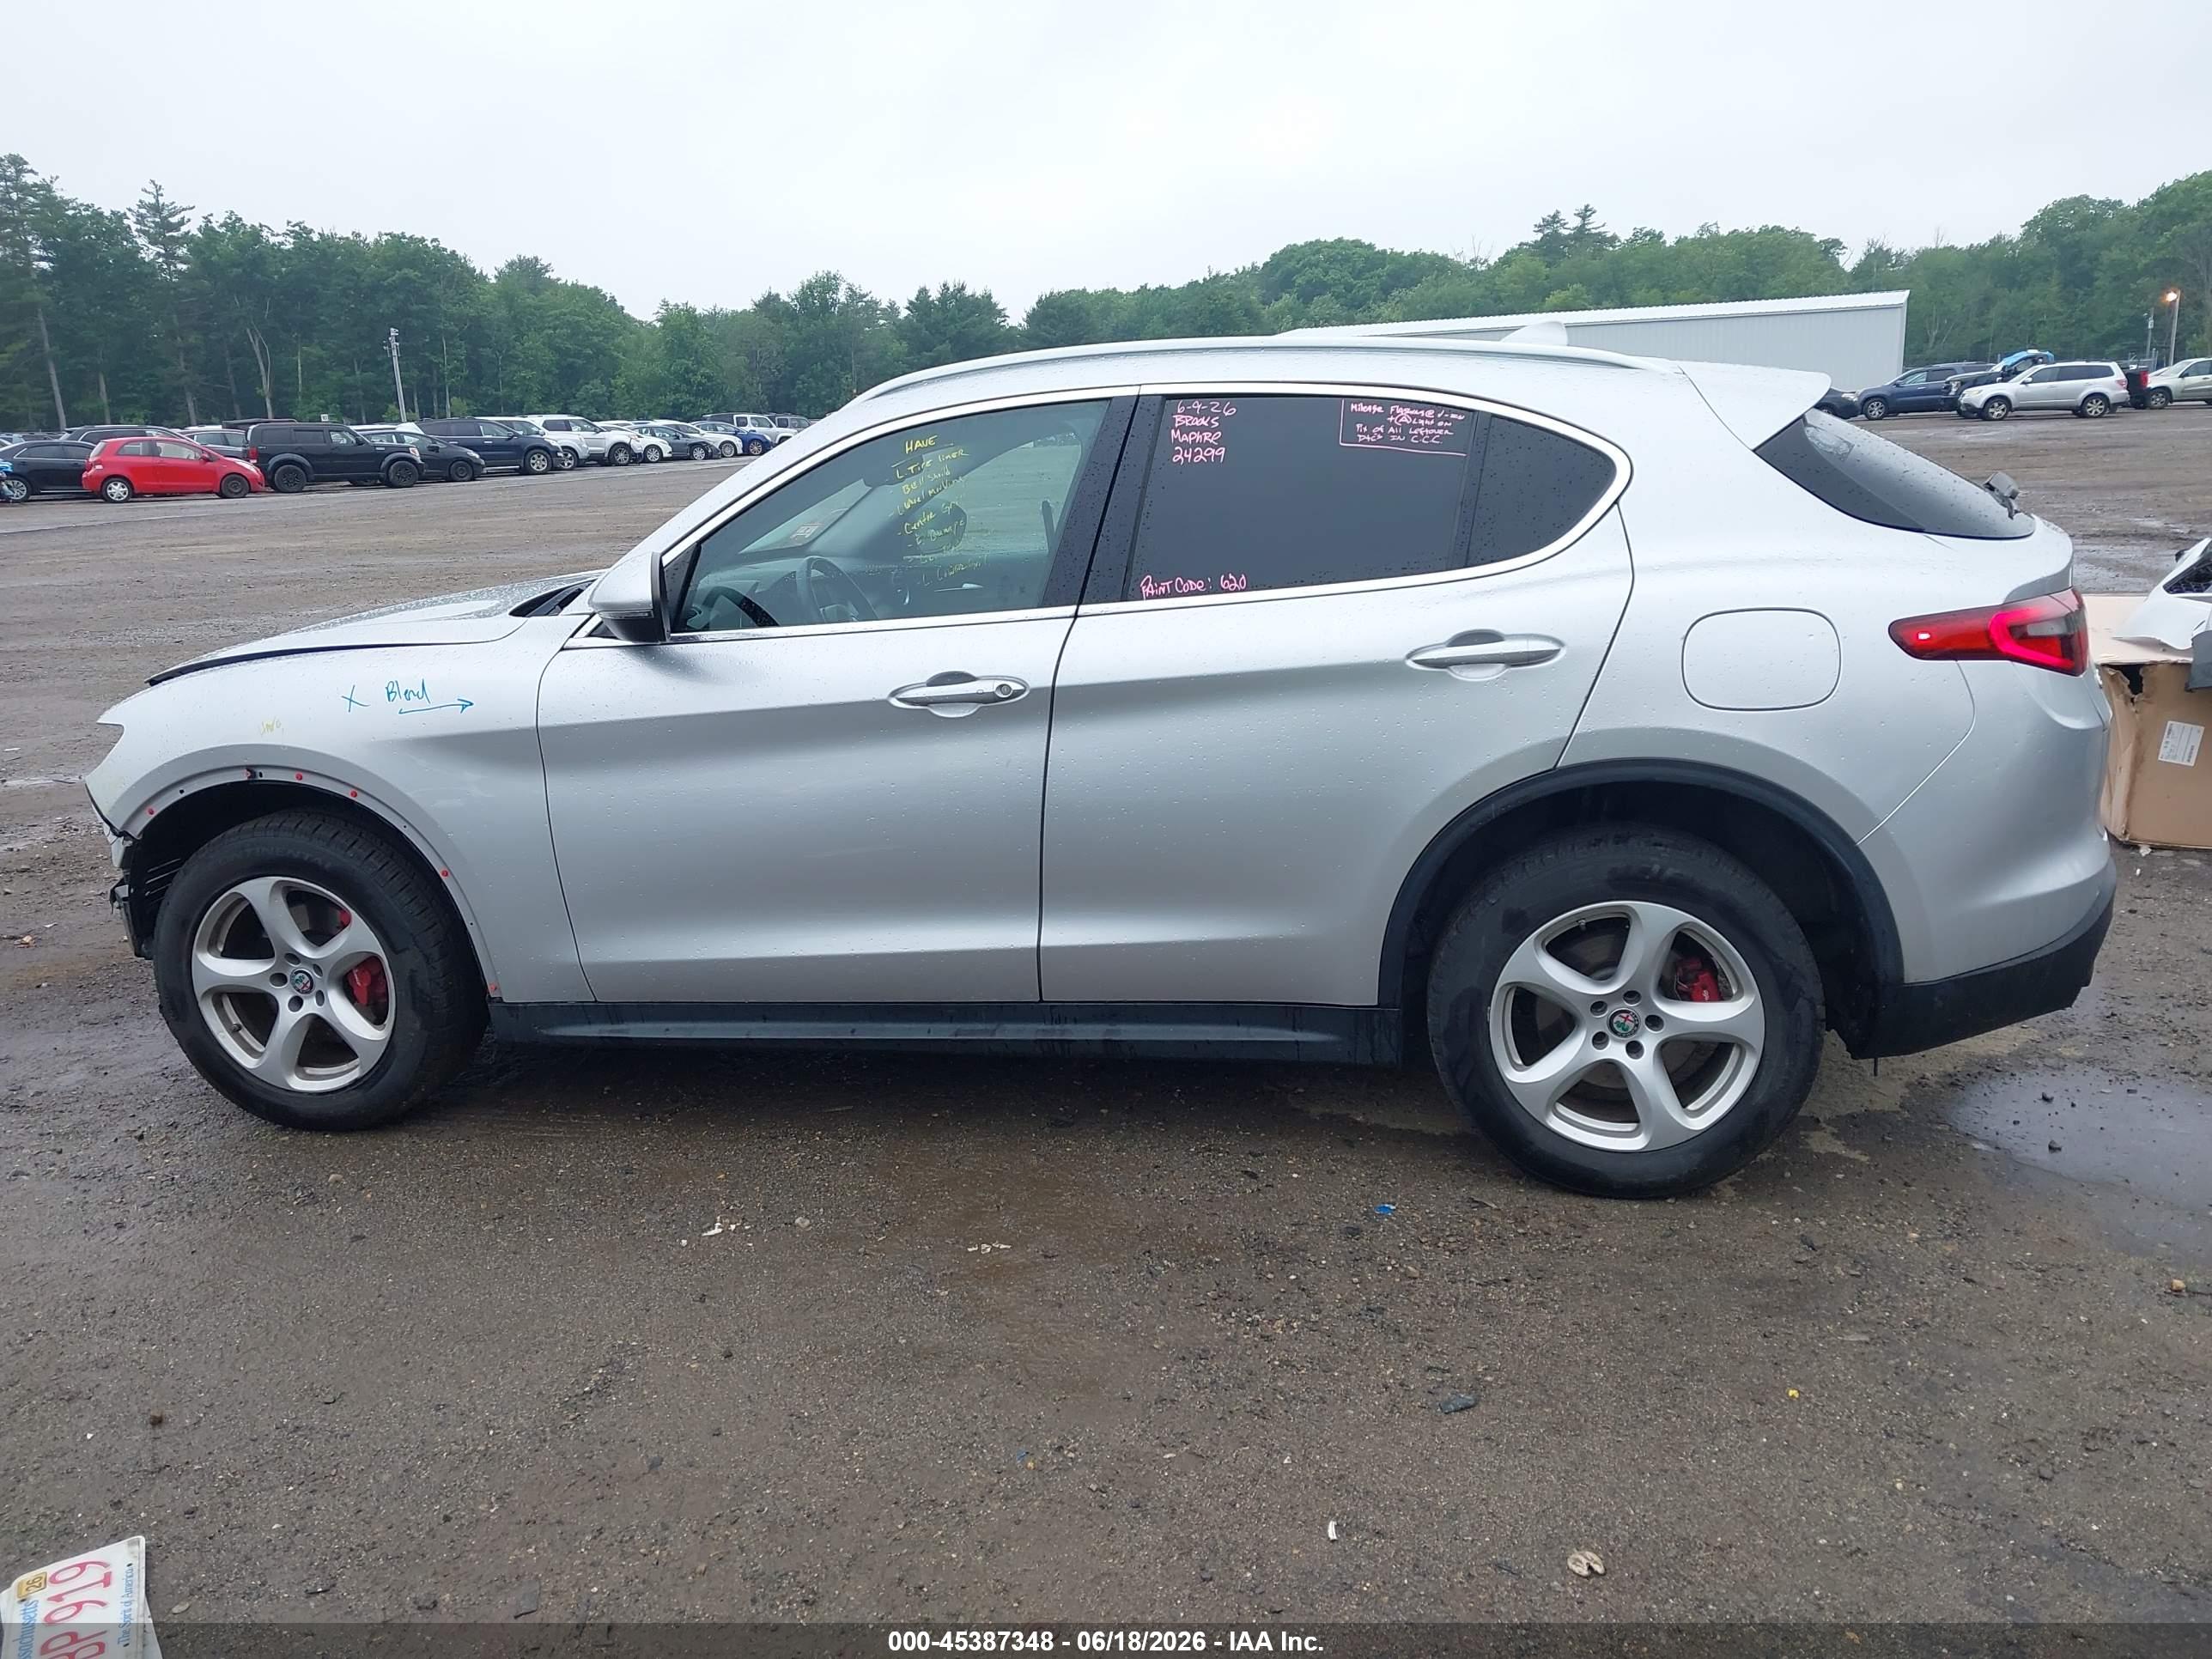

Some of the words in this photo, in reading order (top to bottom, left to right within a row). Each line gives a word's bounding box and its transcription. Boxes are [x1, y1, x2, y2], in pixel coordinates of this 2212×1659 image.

[905, 434, 938, 454] HAVE
[1172, 447, 1225, 465] 24299
[1220, 573, 1246, 591] 620
[386, 678, 431, 703] Blend
[26, 1576, 43, 1592] 26
[44, 1561, 112, 1625] 919
[123, 1569, 134, 1598] America
[118, 1628, 131, 1644] The
